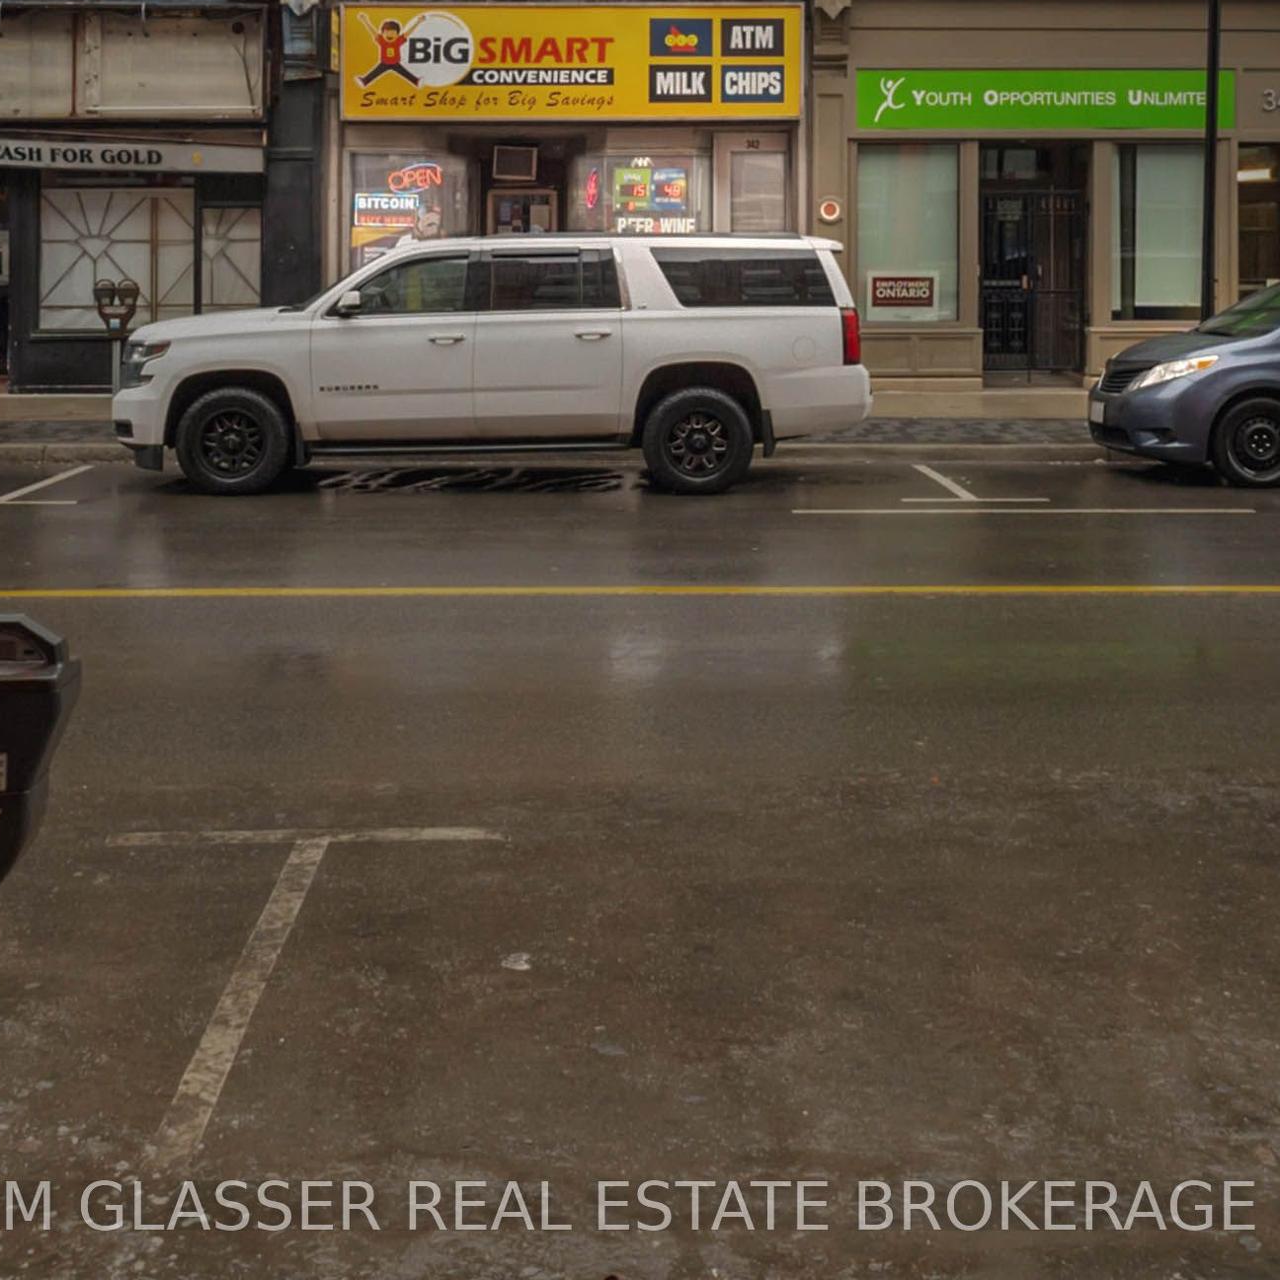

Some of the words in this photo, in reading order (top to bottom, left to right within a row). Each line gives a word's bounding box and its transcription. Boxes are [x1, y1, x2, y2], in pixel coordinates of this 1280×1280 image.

[729, 25, 774, 50] ATM
[478, 36, 616, 64] SMART
[472, 69, 609, 84] CONVENIENCE
[656, 71, 705, 95] MILK
[724, 70, 781, 95] CHIPS
[360, 91, 417, 108] Smart
[424, 91, 468, 111] Shop
[475, 91, 499, 111] for
[508, 90, 537, 111] Big
[546, 90, 615, 110] Savings
[50, 147, 94, 164] FOR
[100, 149, 163, 165] GOLD
[388, 169, 443, 189] OPEN
[358, 197, 415, 209] BITCOIN
[876, 280, 930, 288] EMPLOYMENT
[876, 288, 930, 298] ONTARIO
